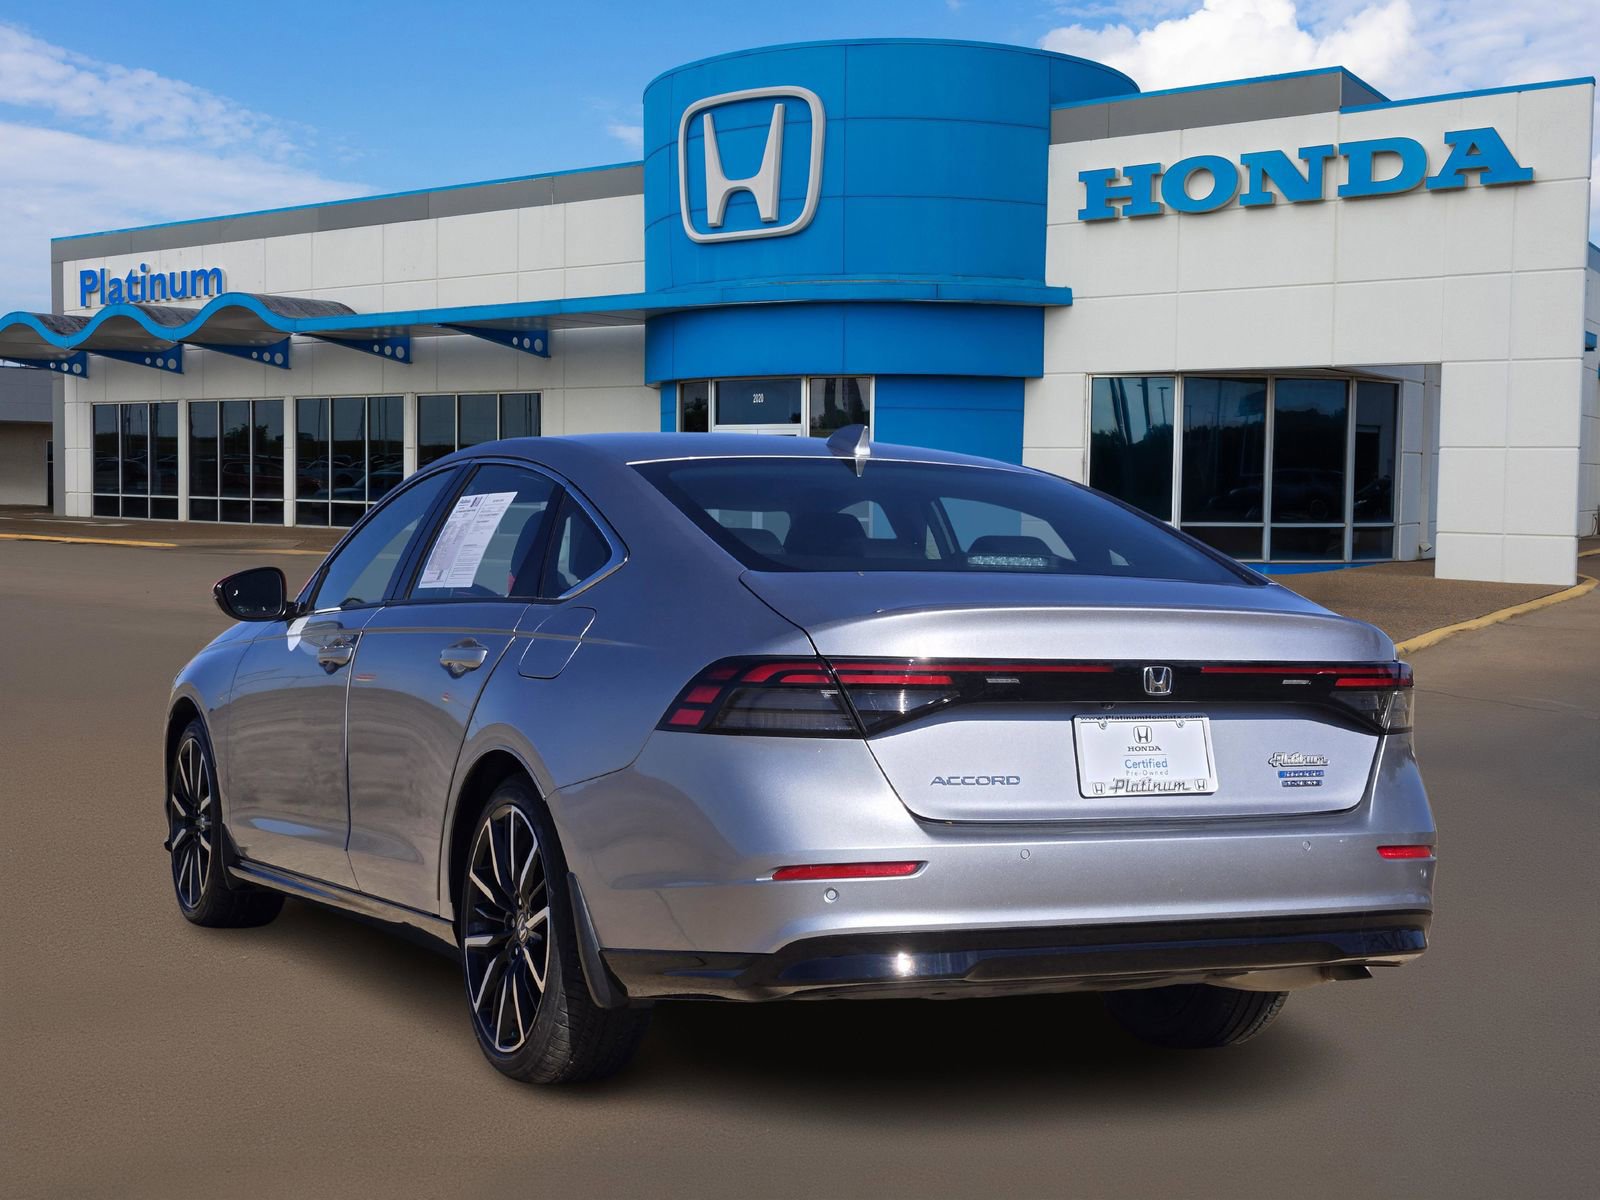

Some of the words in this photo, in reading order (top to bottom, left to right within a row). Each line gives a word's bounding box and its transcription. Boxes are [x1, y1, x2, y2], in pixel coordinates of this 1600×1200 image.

[1078, 127, 1534, 221] HONDA
[80, 263, 227, 307] Platinum
[1124, 757, 1168, 769] Certified
[930, 775, 1021, 786] ACCORD
[1108, 777, 1192, 794] Platinum
